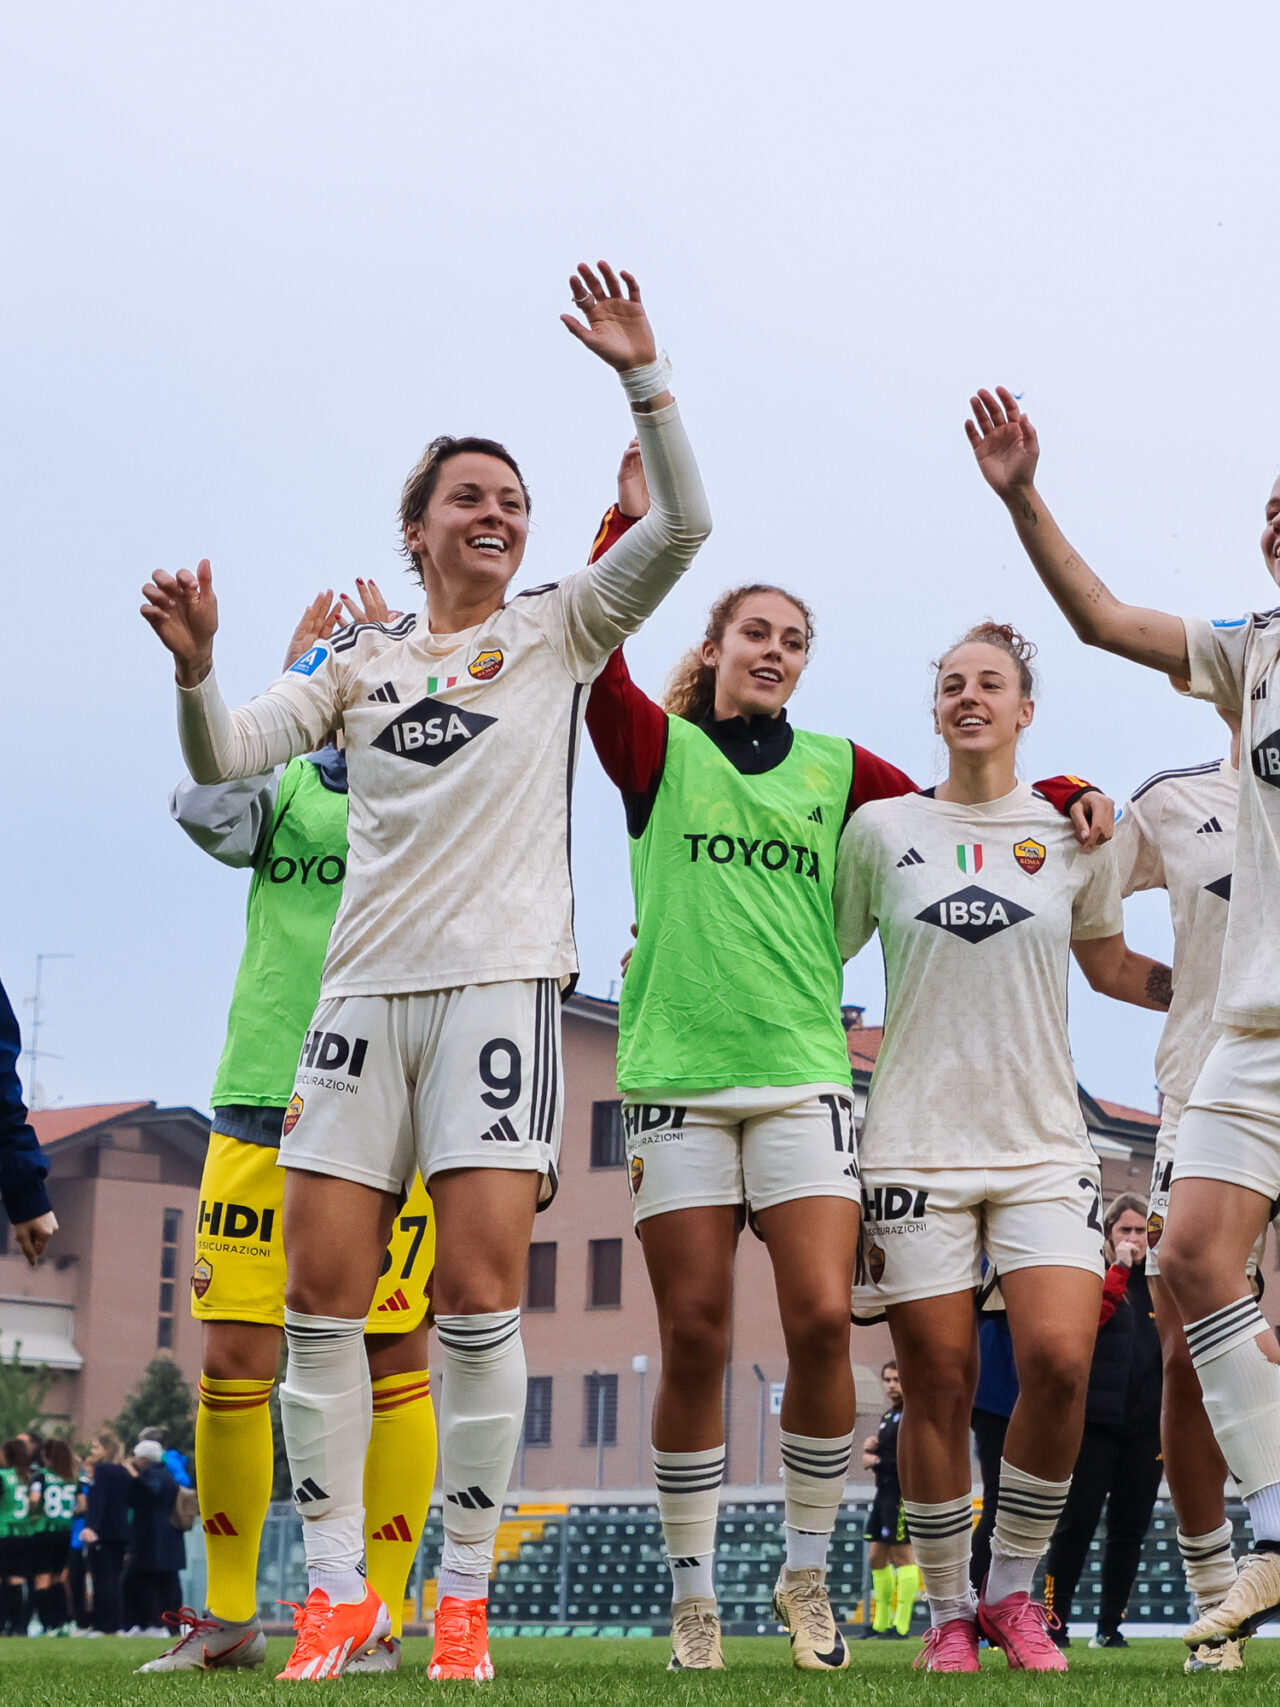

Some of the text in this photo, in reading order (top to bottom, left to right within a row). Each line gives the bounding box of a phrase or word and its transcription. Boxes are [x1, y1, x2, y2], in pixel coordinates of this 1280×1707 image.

[392, 713, 472, 752] IBSA
[264, 855, 345, 885] OYO
[683, 833, 820, 883] TOYOTA
[939, 901, 1010, 925] IBSA
[479, 1038, 521, 1110] 9
[198, 1201, 275, 1242] HDI
[861, 1187, 929, 1222] HDI
[44, 1484, 77, 1518] 85
